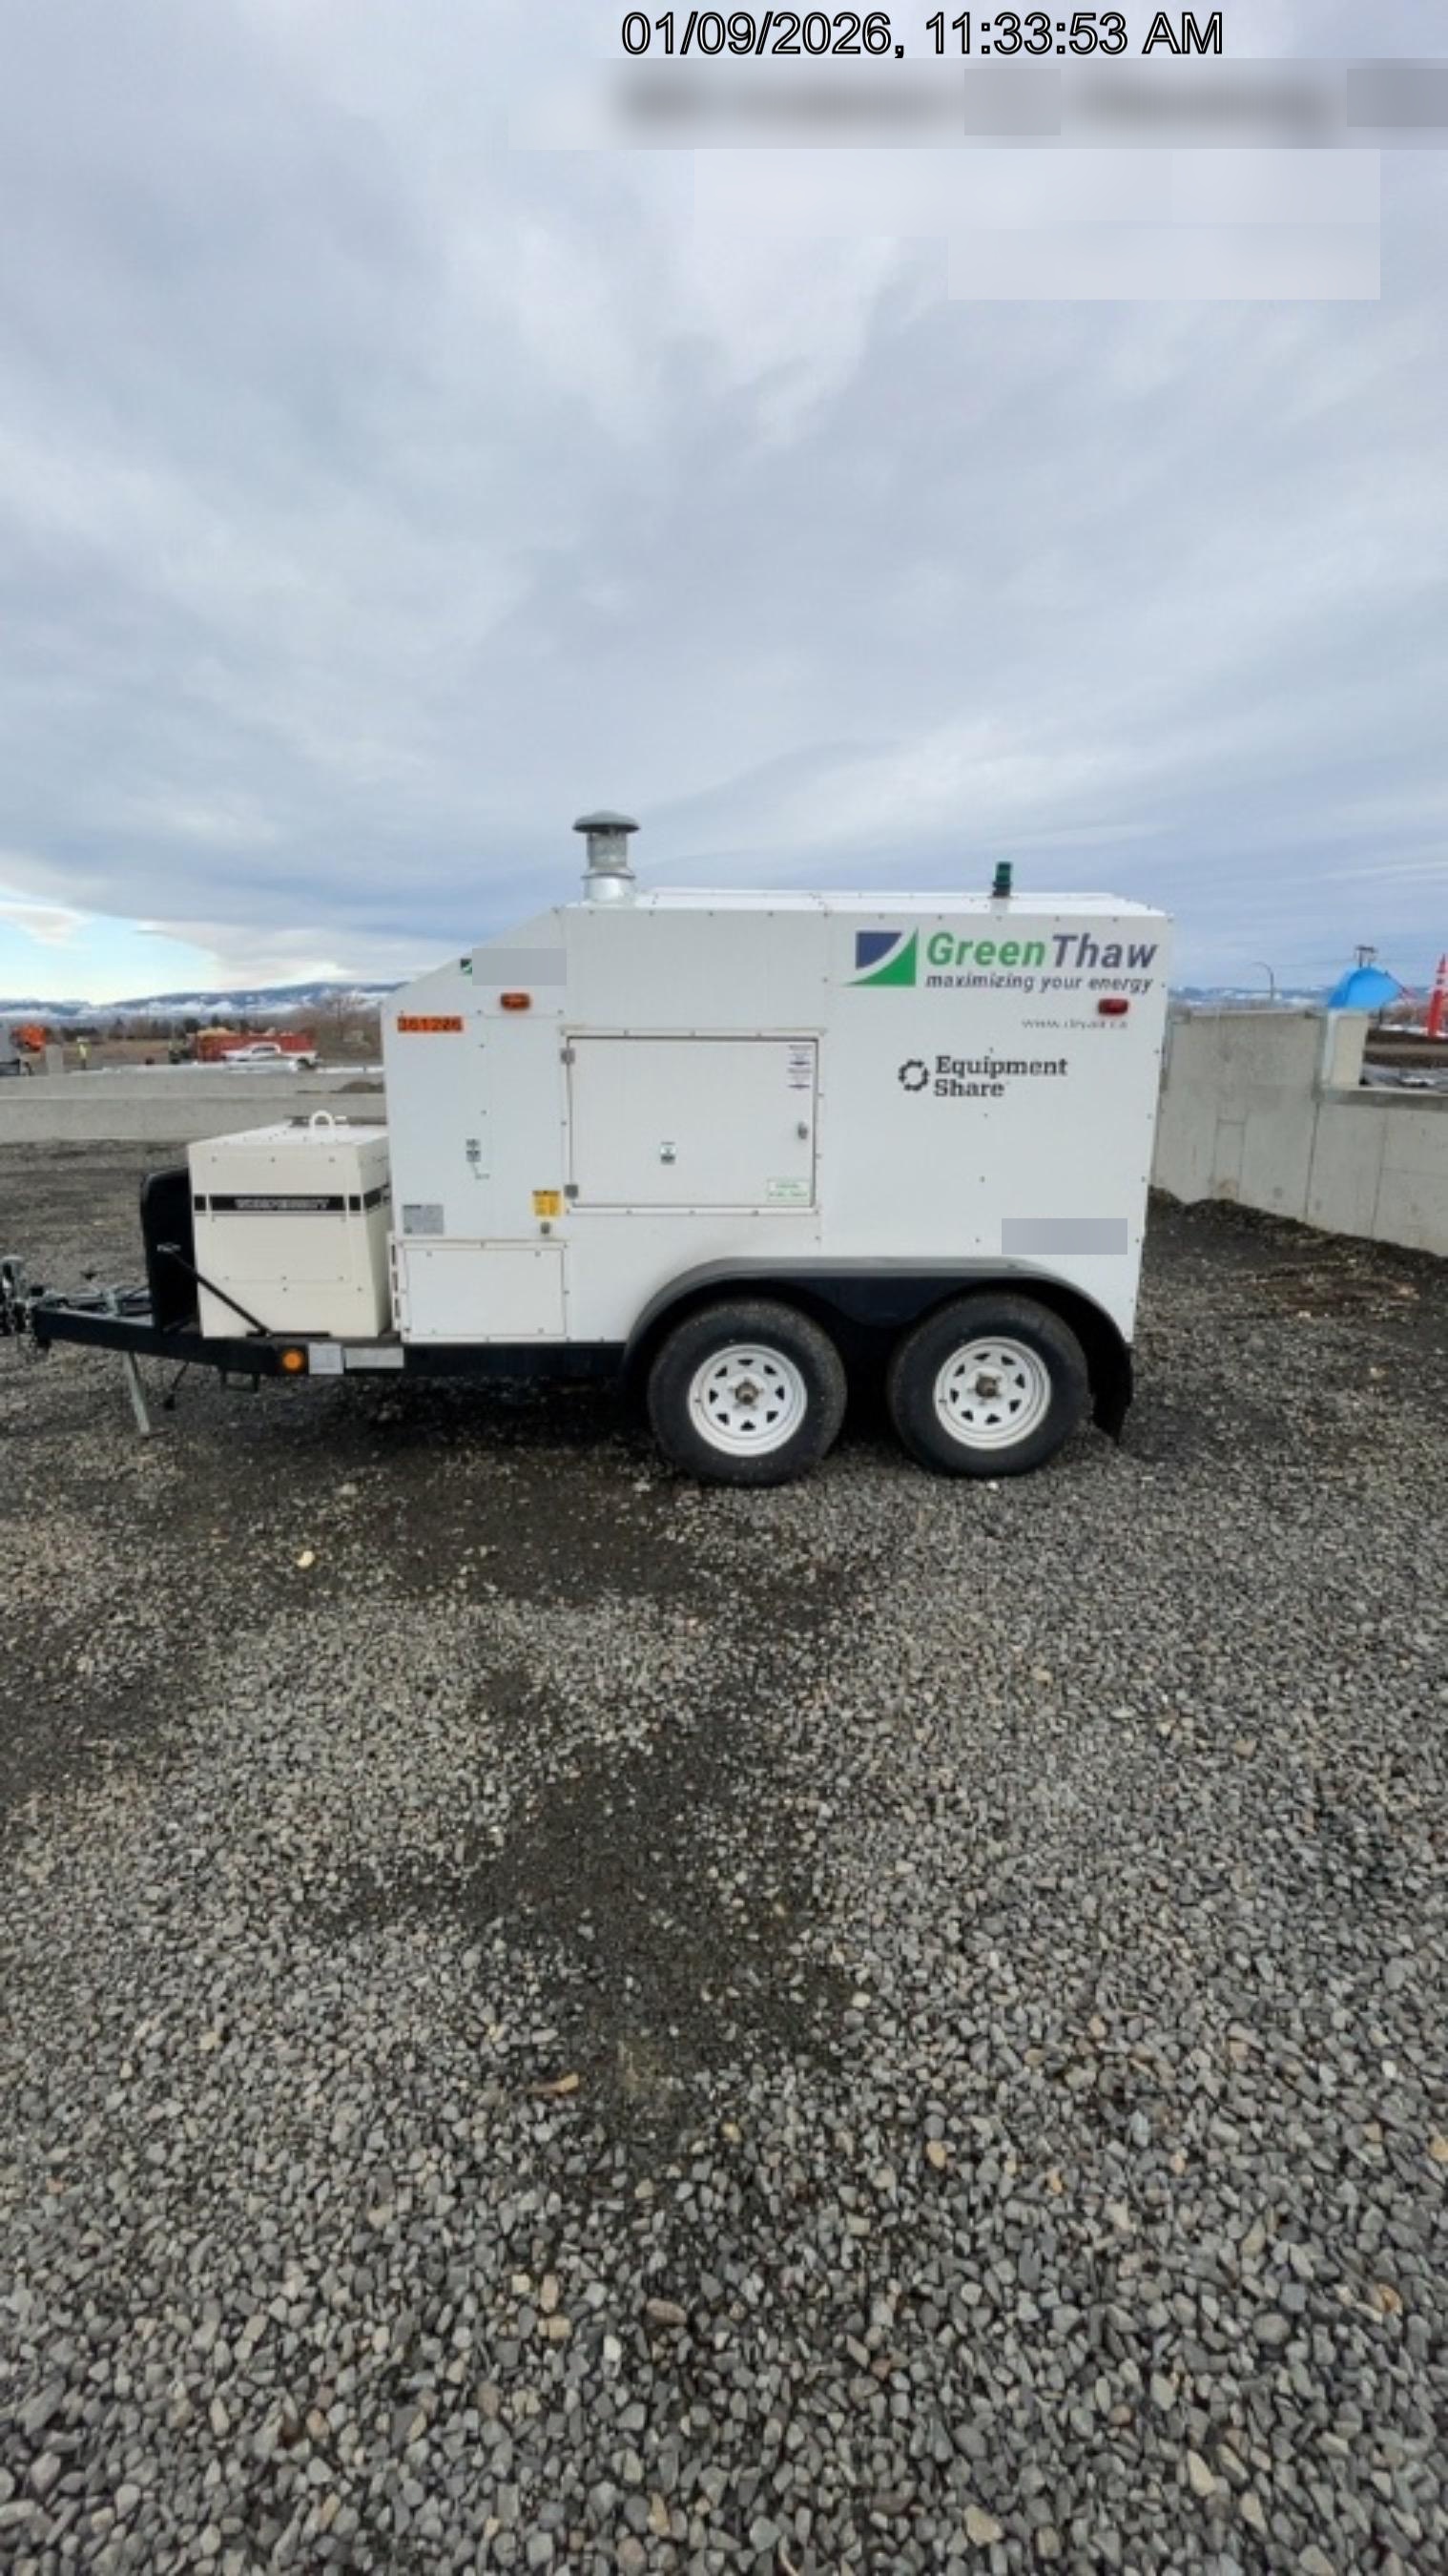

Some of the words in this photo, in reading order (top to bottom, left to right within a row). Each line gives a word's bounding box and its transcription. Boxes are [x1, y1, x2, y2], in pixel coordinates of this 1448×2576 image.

[925, 971, 1035, 994] maximizing
[1039, 974, 1083, 994] your
[1087, 976, 1153, 994] energy
[935, 1055, 1067, 1079] Equipment
[934, 1078, 1004, 1097] Share
